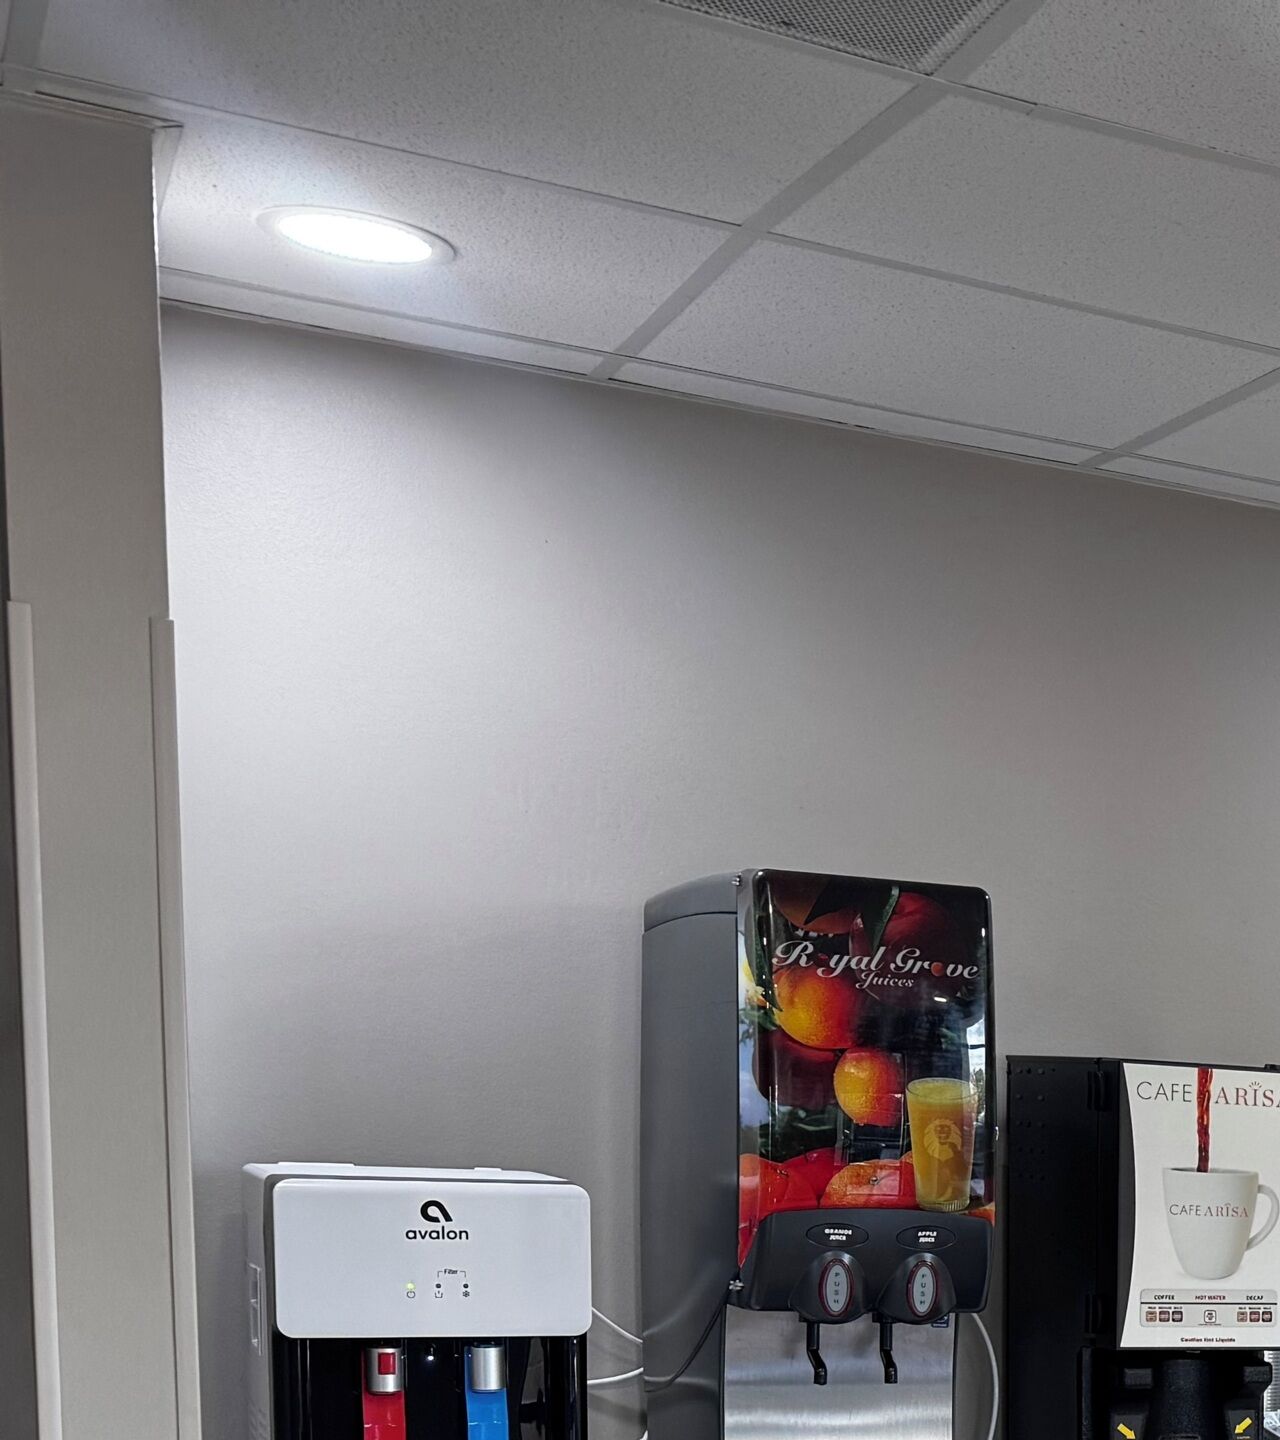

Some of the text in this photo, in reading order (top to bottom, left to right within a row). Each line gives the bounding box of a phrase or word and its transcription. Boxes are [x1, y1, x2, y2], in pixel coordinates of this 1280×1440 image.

[855, 971, 915, 990] Juices
[1136, 1081, 1193, 1103] CAFE
[1169, 1204, 1201, 1217] CAFE
[405, 1225, 469, 1240] avalon
